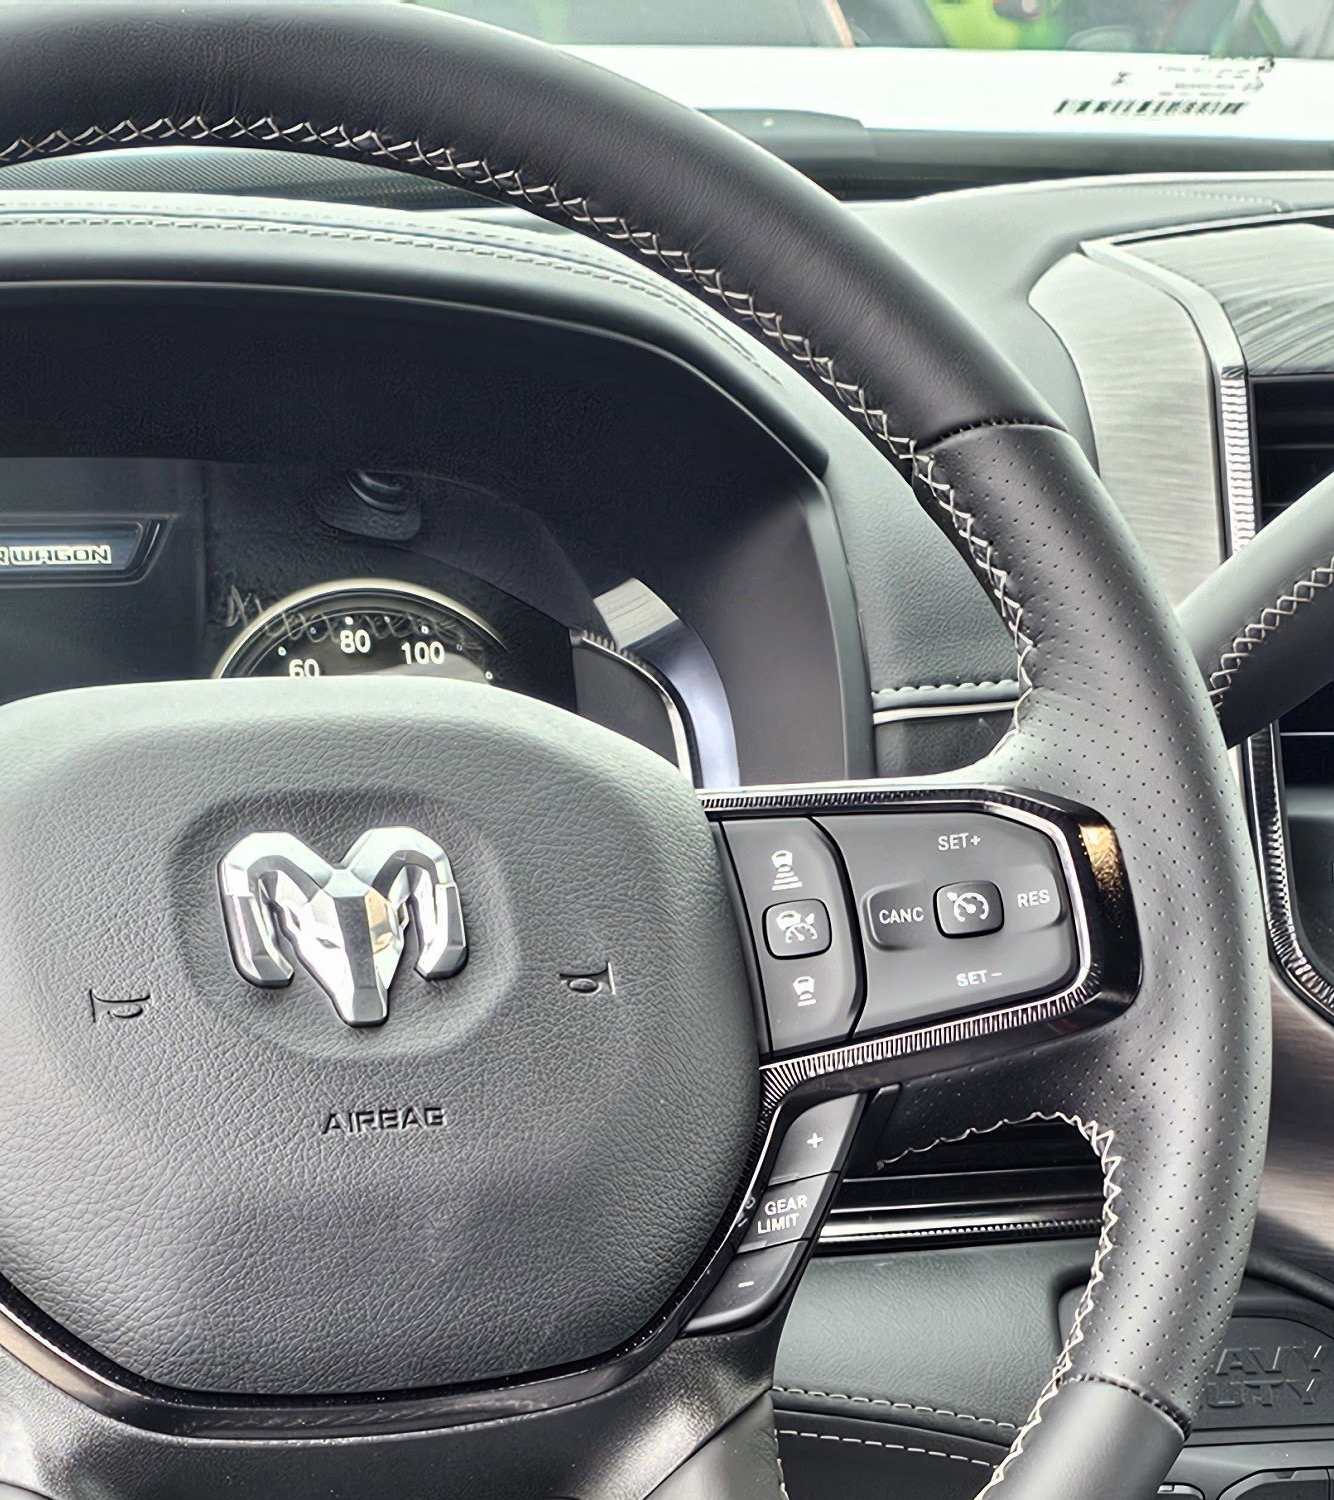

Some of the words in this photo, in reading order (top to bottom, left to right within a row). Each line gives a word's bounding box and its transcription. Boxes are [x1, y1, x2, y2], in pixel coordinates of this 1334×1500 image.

[8, 544, 111, 565] WAGON
[339, 629, 371, 654] 80
[401, 640, 445, 666] 100
[289, 658, 320, 679] 60
[1017, 888, 1051, 910] RES
[878, 905, 925, 926] CANC
[321, 1105, 446, 1135] AIRBAG
[764, 1193, 809, 1217] GEAR
[756, 1211, 801, 1235] LIMIT
